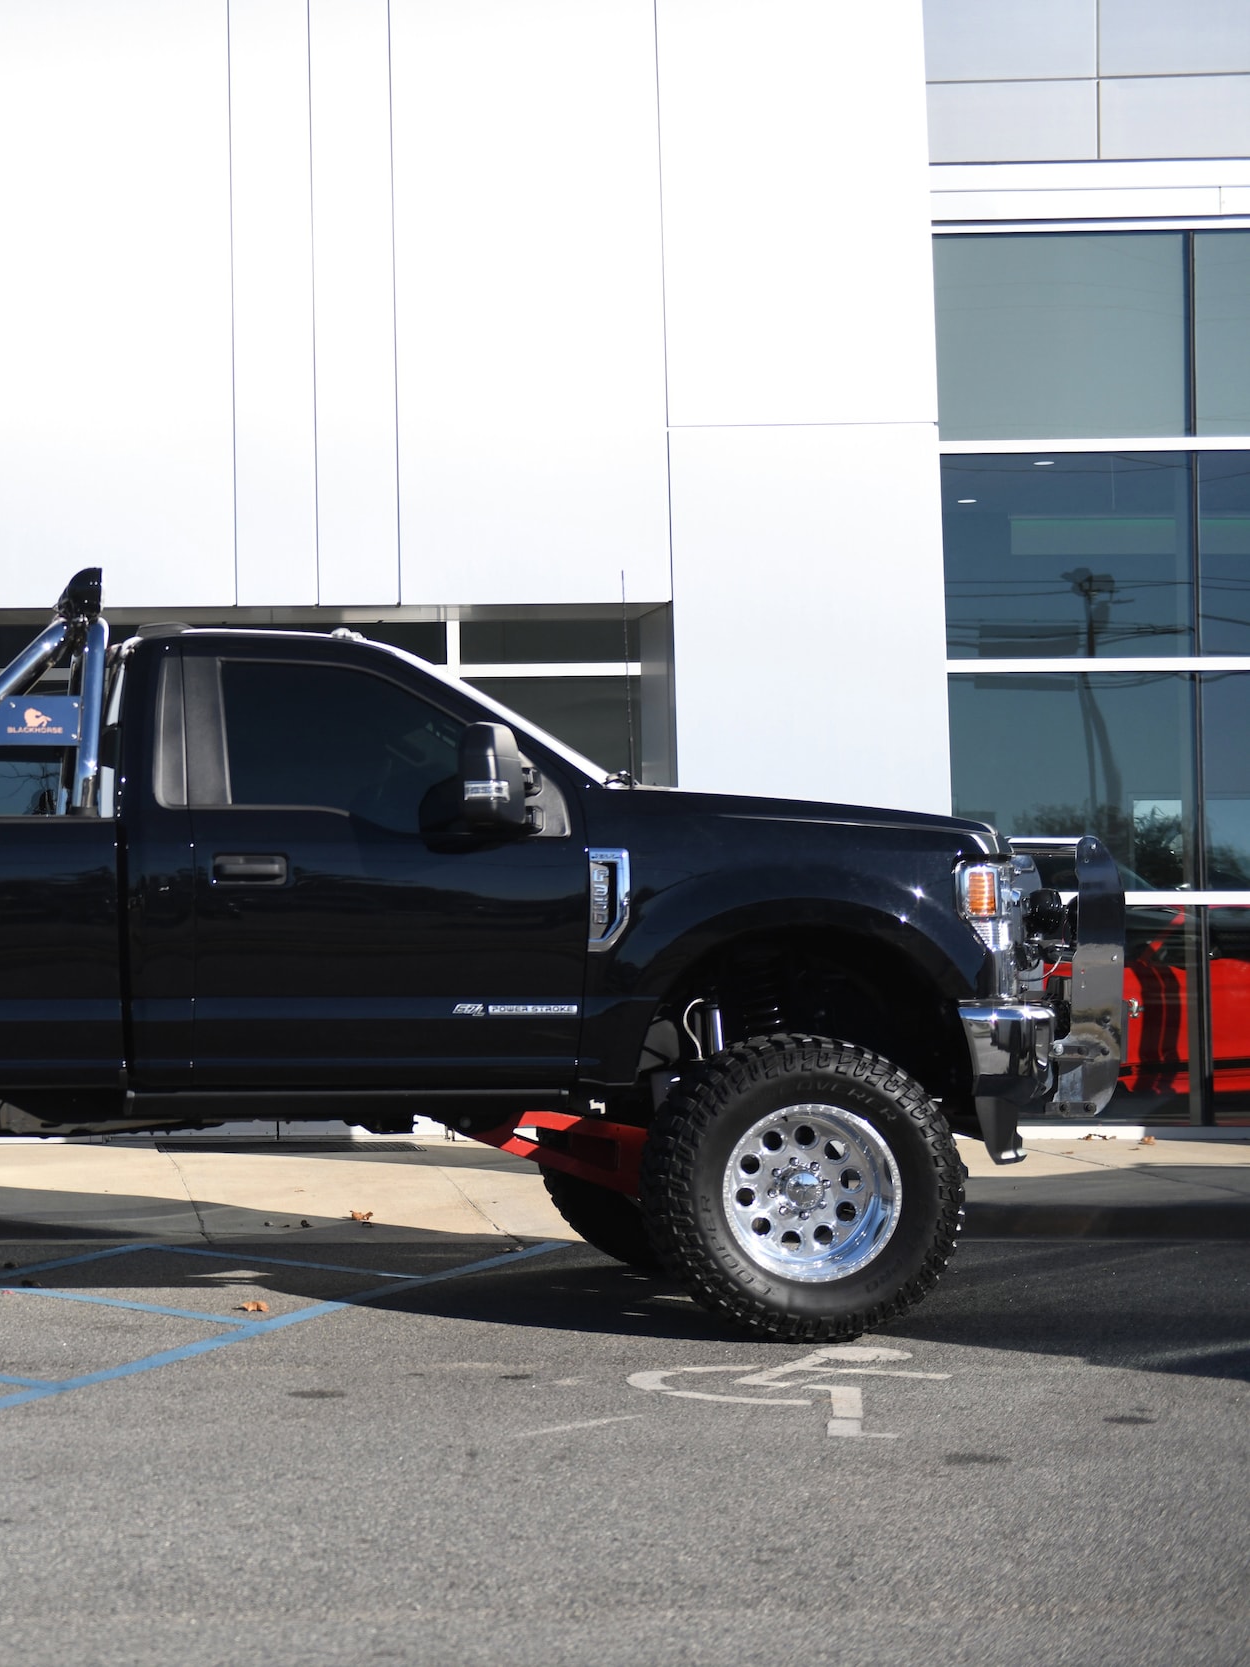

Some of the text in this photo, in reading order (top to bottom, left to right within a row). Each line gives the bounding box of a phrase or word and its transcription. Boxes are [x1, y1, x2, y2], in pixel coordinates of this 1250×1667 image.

[7, 726, 64, 734] BLACKHORSE
[491, 1005, 528, 1013] POWER
[531, 1005, 573, 1013] STROKE
[699, 1195, 772, 1296] COOPER
